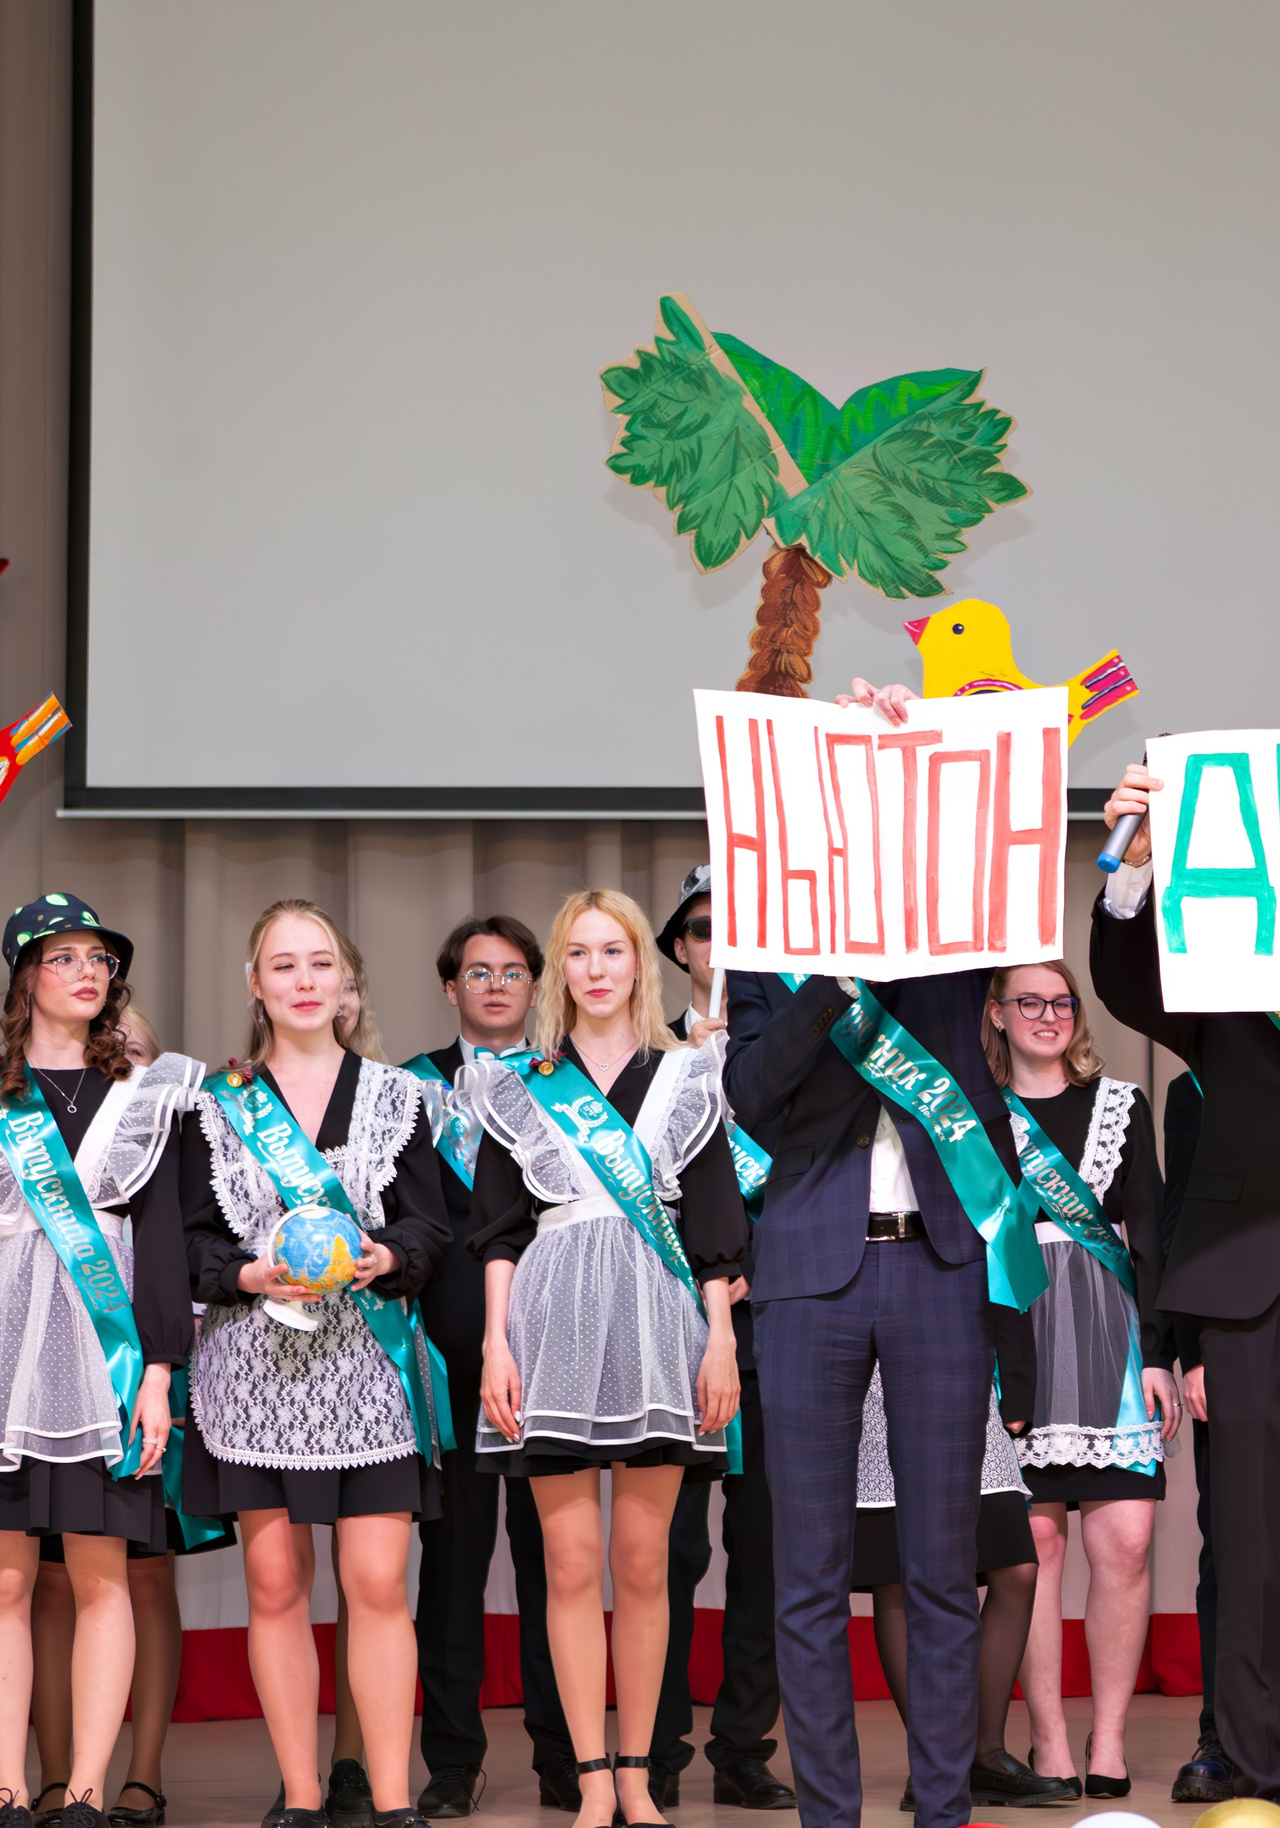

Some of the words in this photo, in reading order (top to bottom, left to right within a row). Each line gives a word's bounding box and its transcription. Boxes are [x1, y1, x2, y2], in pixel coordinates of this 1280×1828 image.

[715, 714, 1062, 957] НЬЮТОН
[916, 1076, 978, 1143] 2024
[7, 1110, 96, 1260] Выпускница
[82, 1259, 128, 1314] 2024
[1019, 1141, 1094, 1228] пускник
